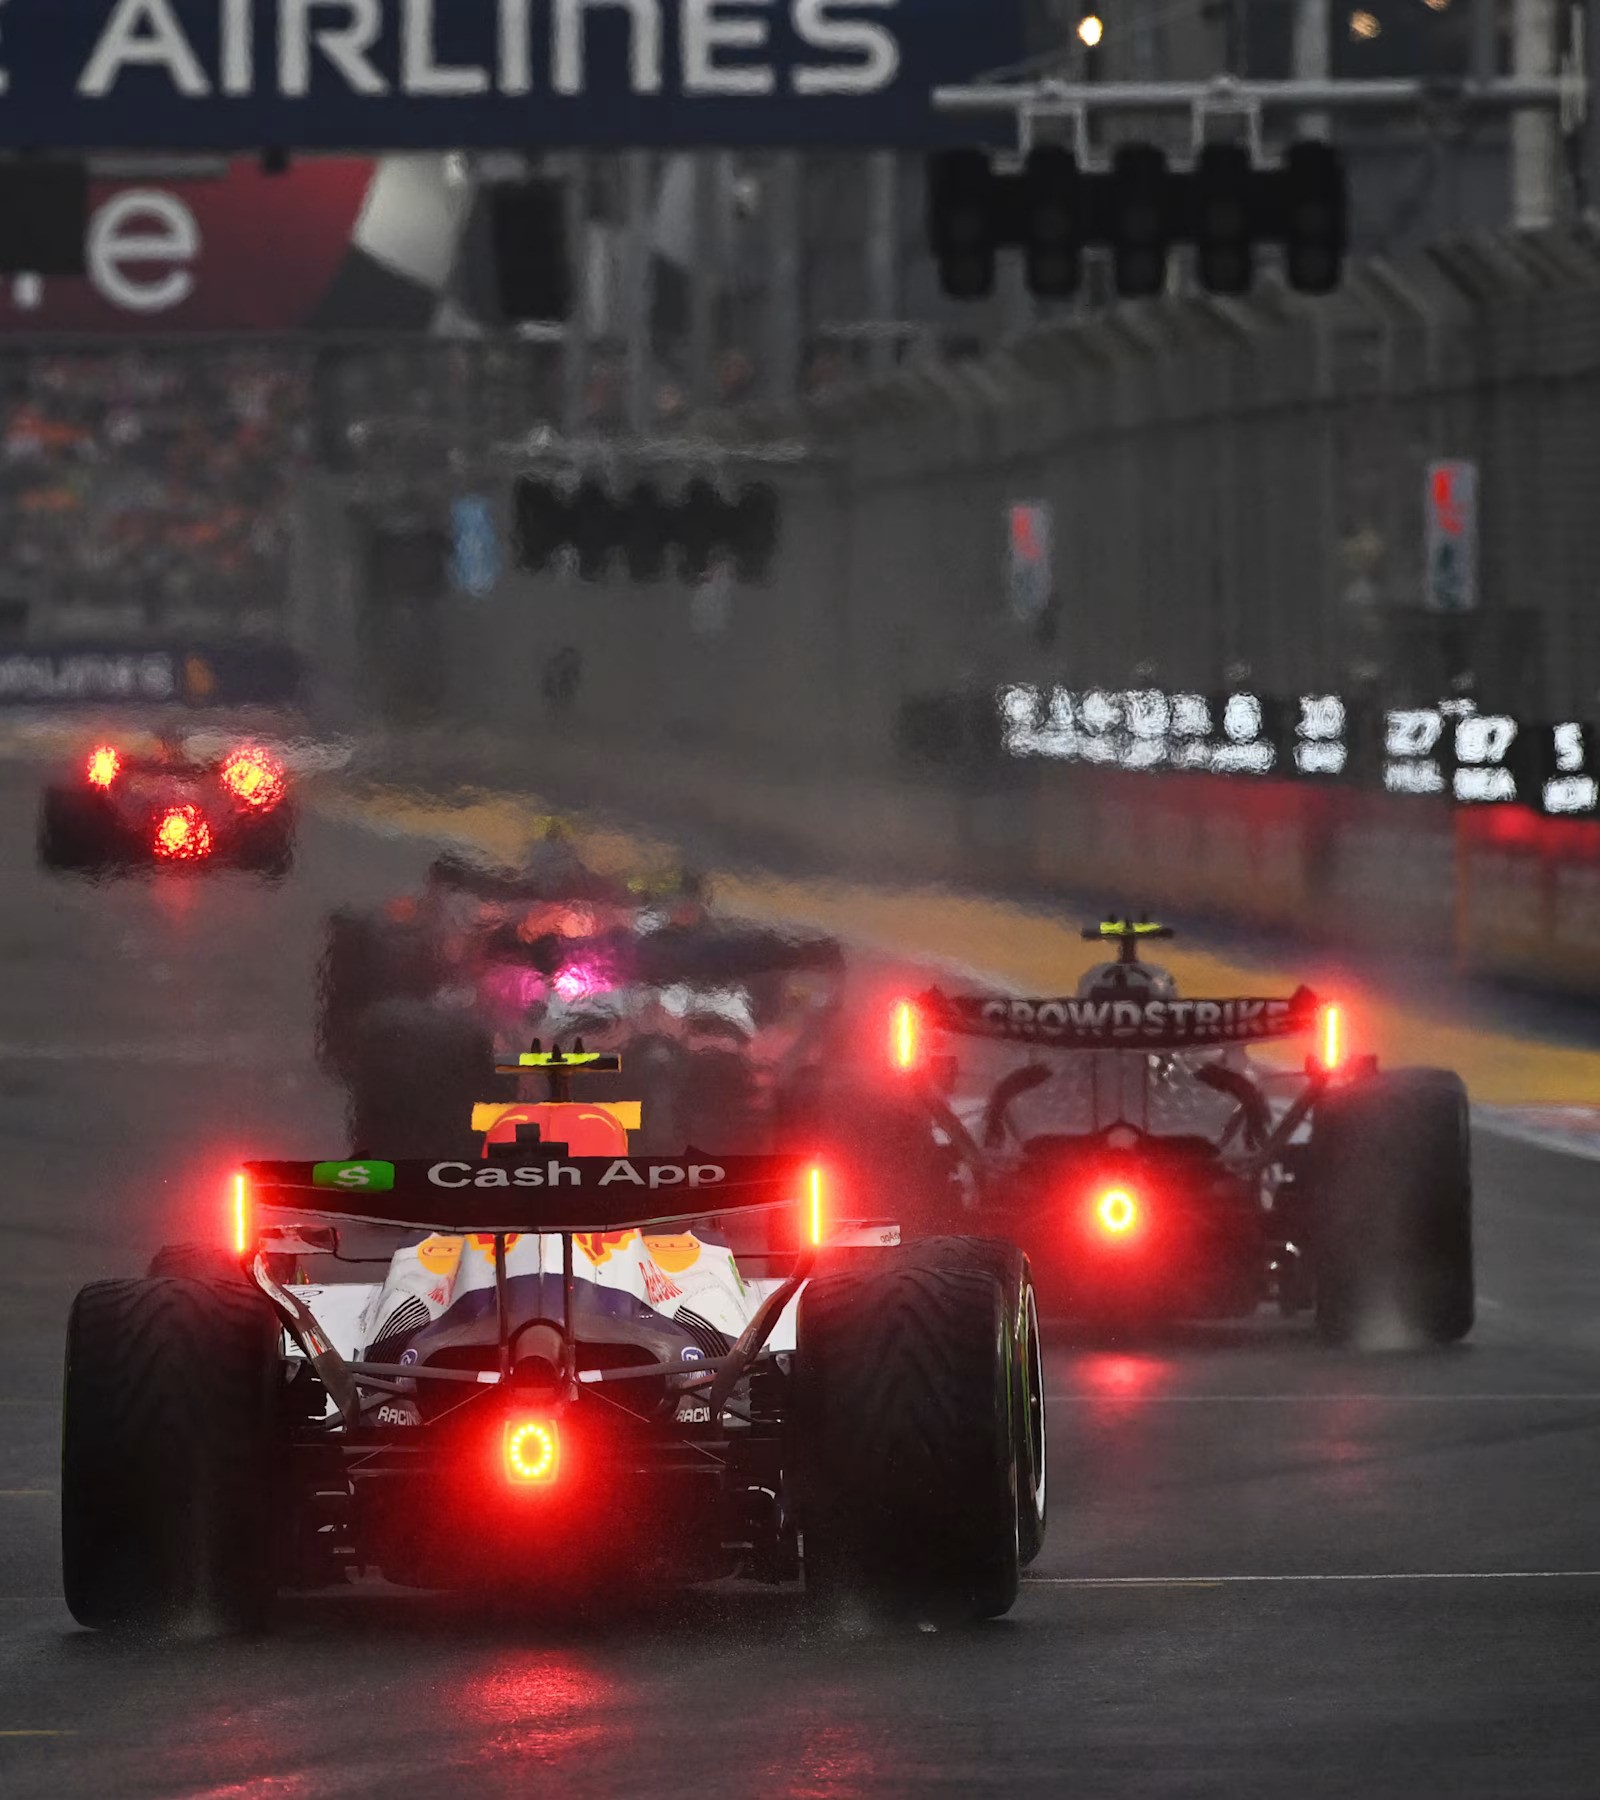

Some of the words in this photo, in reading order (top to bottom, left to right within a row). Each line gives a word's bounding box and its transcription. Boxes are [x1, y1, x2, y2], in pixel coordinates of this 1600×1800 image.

[76, 0, 900, 96] AIRLINES
[981, 1000, 1291, 1033] CROWDSTRIKE
[427, 1159, 582, 1188] Cash
[598, 1158, 727, 1190] App
